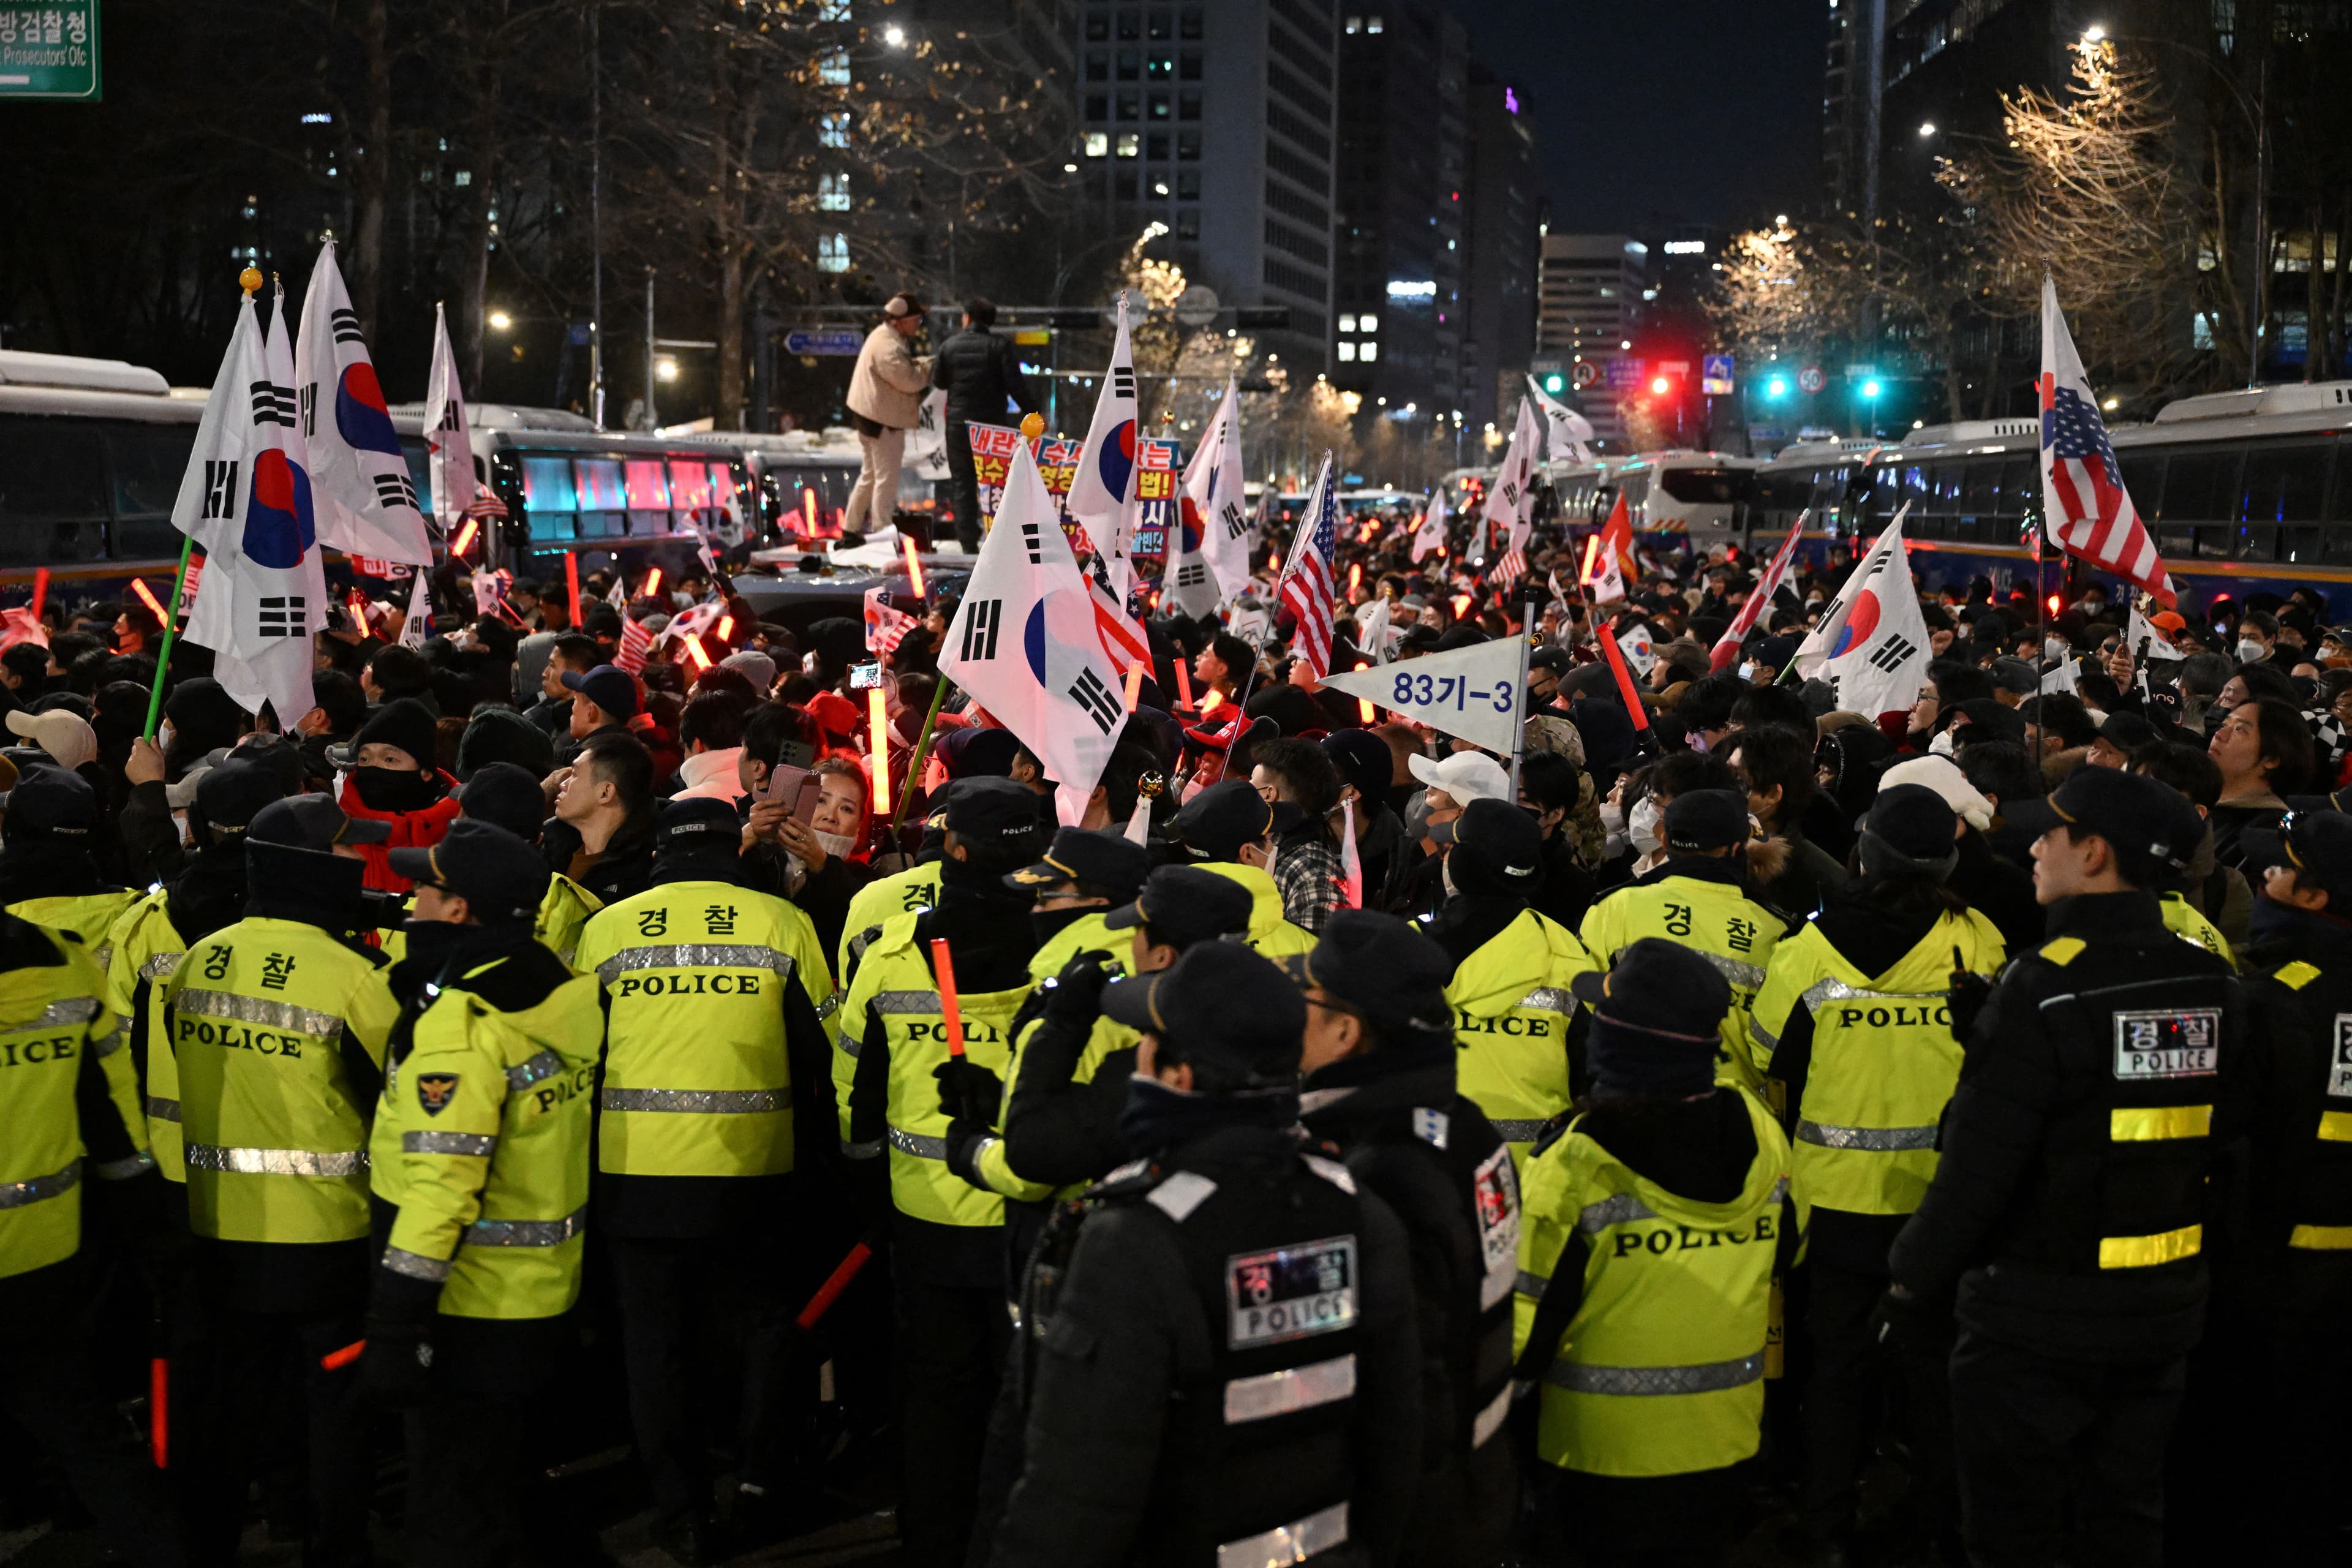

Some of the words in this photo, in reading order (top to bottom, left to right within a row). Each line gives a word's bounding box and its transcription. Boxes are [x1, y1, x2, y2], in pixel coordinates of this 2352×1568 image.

[1803, 372, 1819, 387] 50
[970, 426, 1041, 462] 내란
[1393, 673, 1512, 712] 83기-3
[674, 824, 703, 833] POLICE
[1003, 825, 1033, 835] POLICE
[620, 974, 760, 997] POLICE
[1453, 1012, 1549, 1036] LICE
[1839, 1006, 1950, 1027] POLIC
[179, 1020, 301, 1058] POLICE
[0, 1036, 75, 1066] ICE
[2133, 1050, 2208, 1072] POLICE
[1612, 1215, 1776, 1257] POLICE
